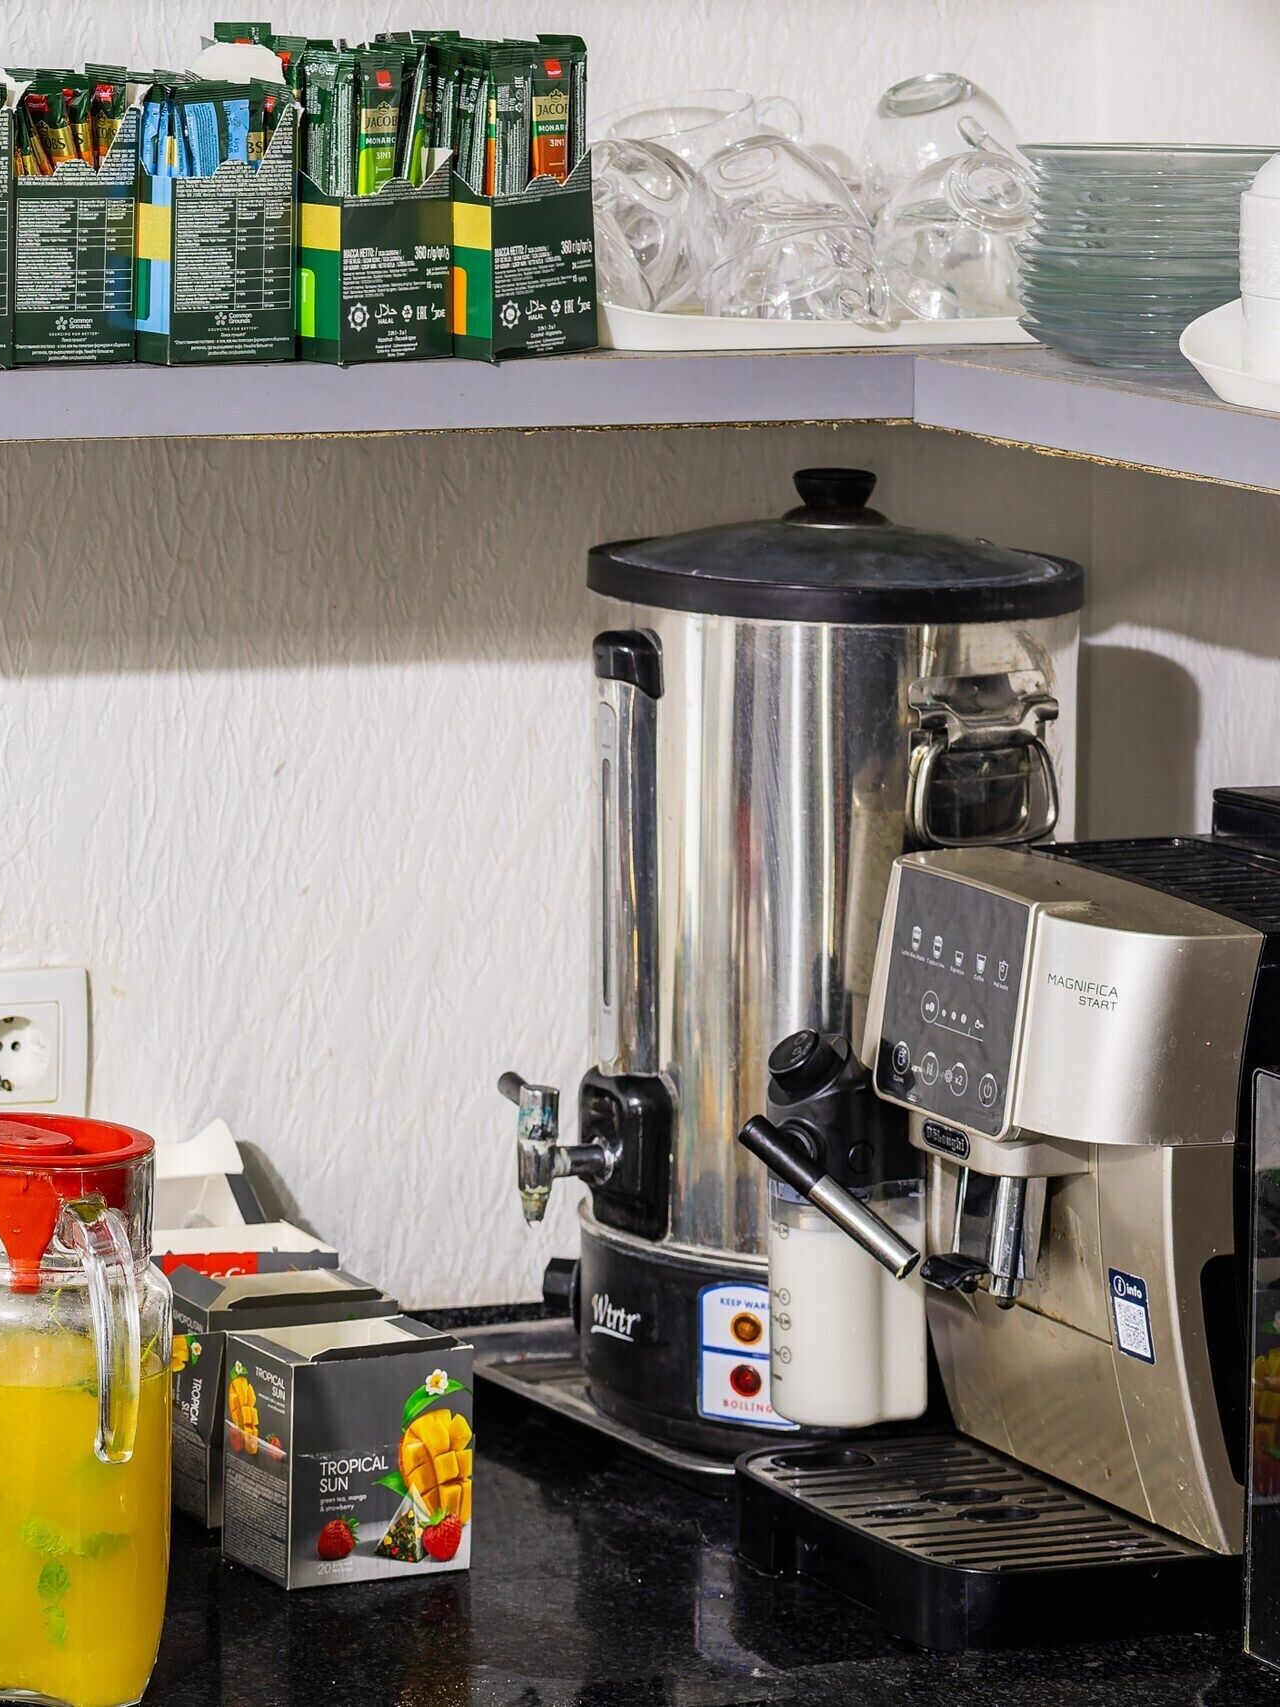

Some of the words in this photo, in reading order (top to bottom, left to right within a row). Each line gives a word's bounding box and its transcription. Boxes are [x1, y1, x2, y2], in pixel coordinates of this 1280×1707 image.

[365, 116, 398, 129] JACOB
[1047, 973, 1119, 998] MAGNIFICA
[1078, 996, 1118, 1011] START
[1126, 1283, 1142, 1299] info
[720, 1297, 742, 1307] KEEP
[255, 1366, 285, 1389] TROPICAL
[272, 1386, 285, 1401] SUN
[723, 1399, 772, 1413] BOILING
[320, 1456, 389, 1476] TROPICAL
[320, 1477, 348, 1493] SUN
[348, 1494, 367, 1502] mango
[326, 1503, 354, 1511] strawberry
[318, 1564, 331, 1575] 20
